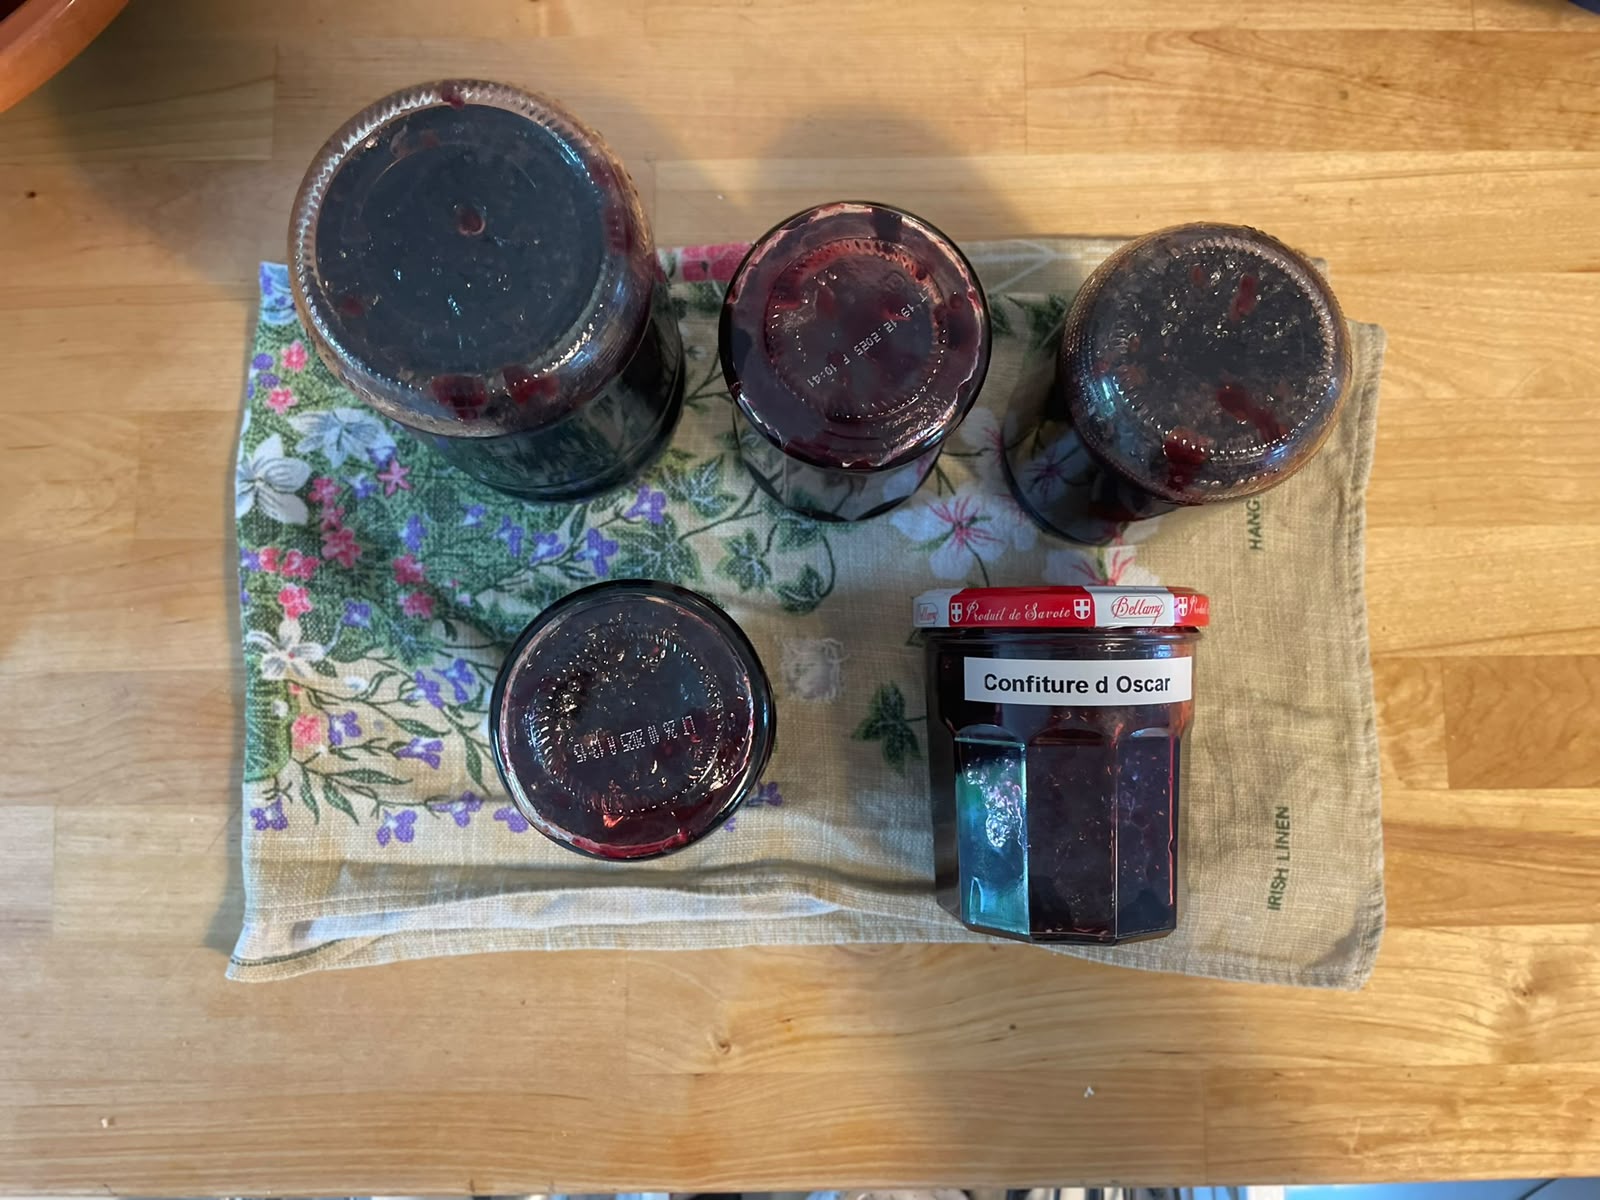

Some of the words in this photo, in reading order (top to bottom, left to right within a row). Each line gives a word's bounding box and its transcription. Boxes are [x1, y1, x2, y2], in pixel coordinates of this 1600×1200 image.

[807, 363, 838, 387] 10:41
[965, 597, 1006, 622] Produit
[1008, 607, 1022, 621] de
[1024, 603, 1071, 621] Savoie
[1113, 597, 1164, 625] Bellamy
[984, 673, 1089, 694] Confiture
[1095, 676, 1108, 693] d
[1116, 675, 1171, 694] Oscar
[1275, 806, 1290, 861] LINEN
[1267, 868, 1289, 911] IRISH
